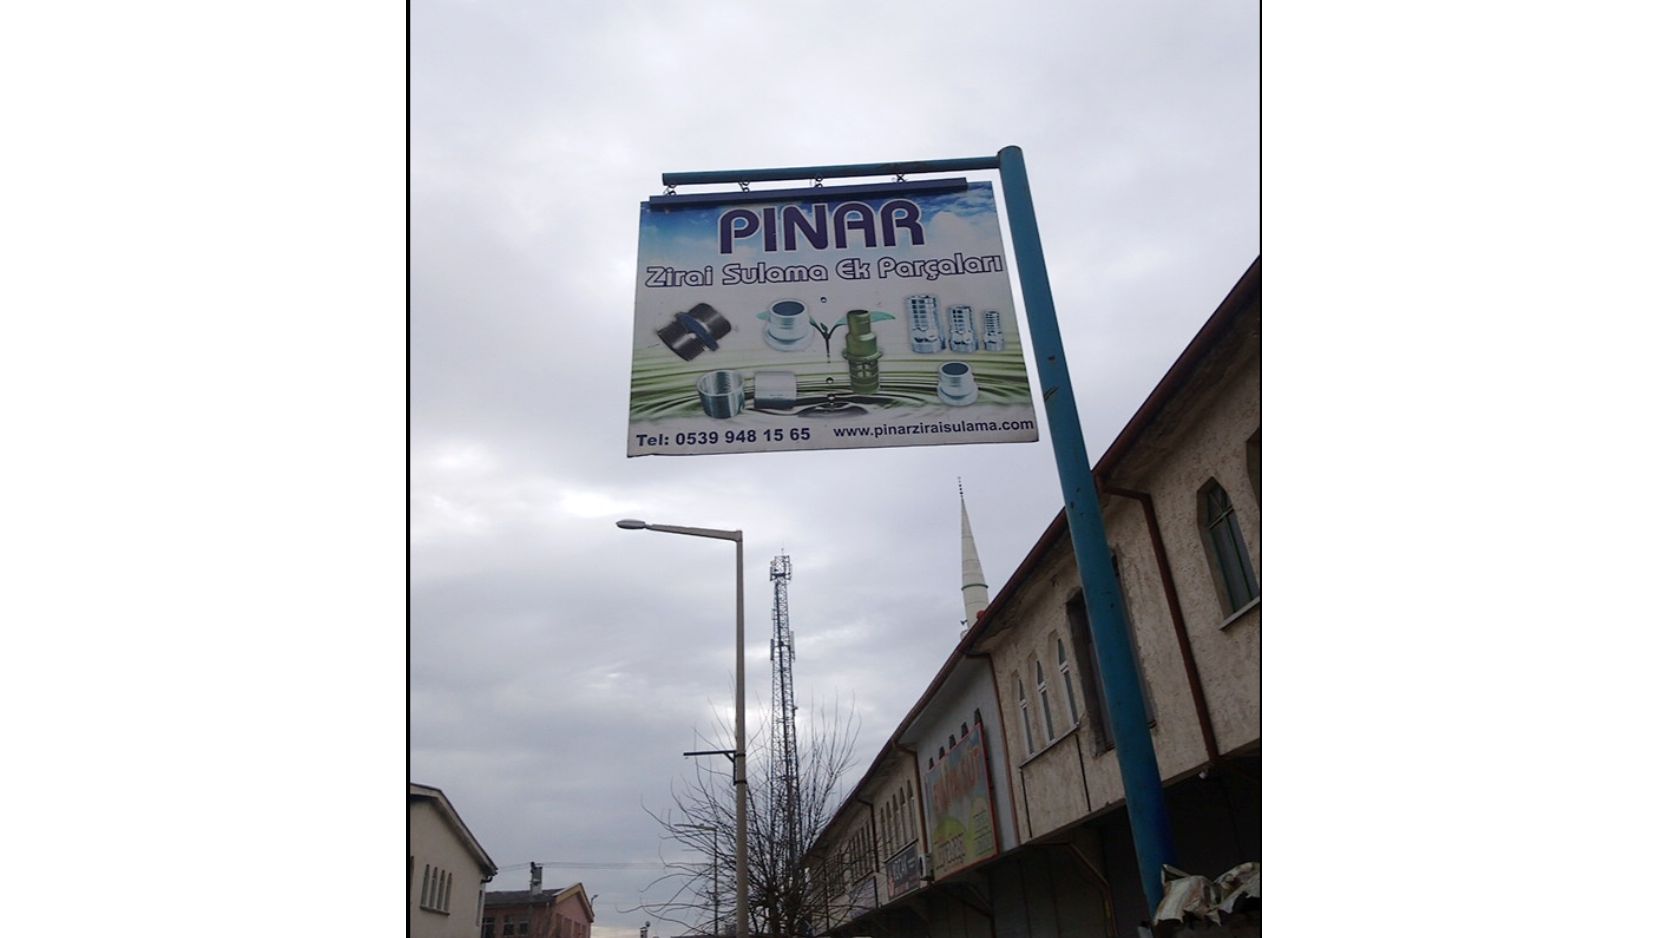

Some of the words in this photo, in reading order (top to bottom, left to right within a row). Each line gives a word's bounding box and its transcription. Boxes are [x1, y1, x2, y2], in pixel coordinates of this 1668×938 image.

[718, 199, 925, 255] PINAR
[645, 265, 713, 287] Zirai
[722, 261, 829, 285] Sulama
[836, 258, 870, 280] Ek
[878, 253, 1004, 280] Parçaları
[636, 433, 669, 446] Tel:
[675, 431, 719, 445] 0539
[725, 429, 757, 443] 948
[763, 428, 784, 442] 15
[790, 426, 811, 441] 65
[833, 418, 1035, 438] www.pinarziraisulama.com
